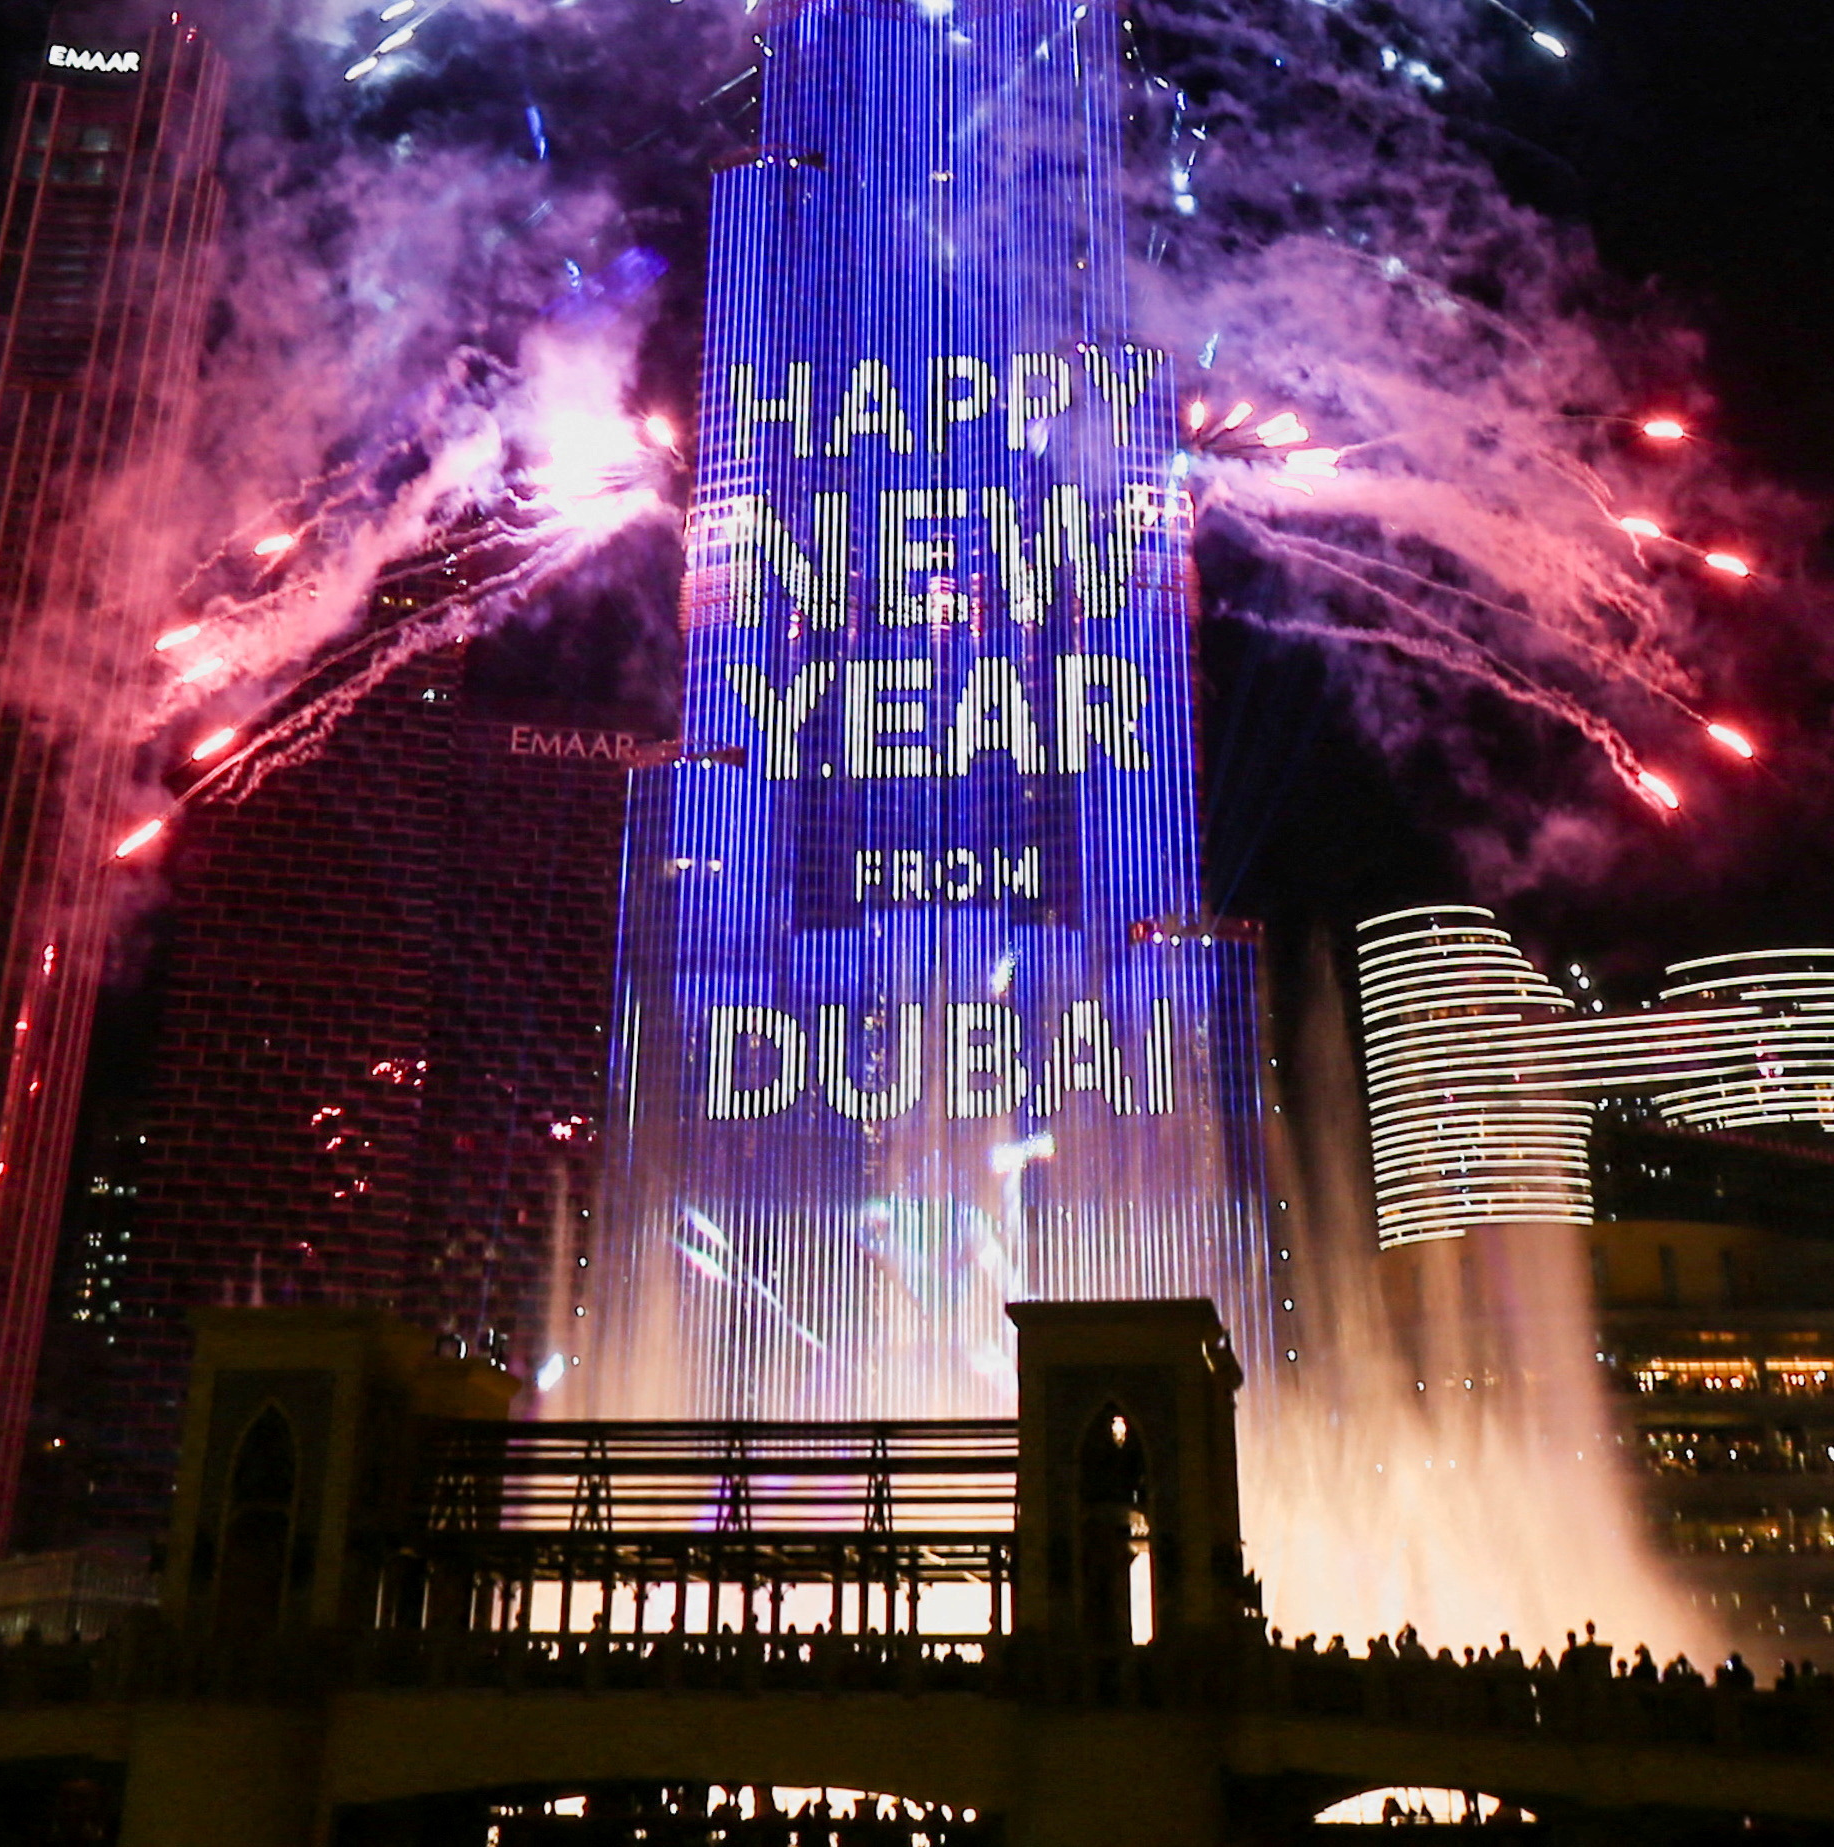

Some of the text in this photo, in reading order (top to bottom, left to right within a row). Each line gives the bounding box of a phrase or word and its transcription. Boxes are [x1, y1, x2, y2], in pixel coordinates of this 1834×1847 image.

[49, 45, 140, 72] EMAAR
[730, 348, 1164, 459] HAPPY
[729, 484, 1151, 631] NEW
[510, 725, 638, 760] EMAAR
[725, 654, 1150, 780] YEAR
[855, 846, 1039, 902] FROM
[707, 997, 1174, 1121] DUBAI
